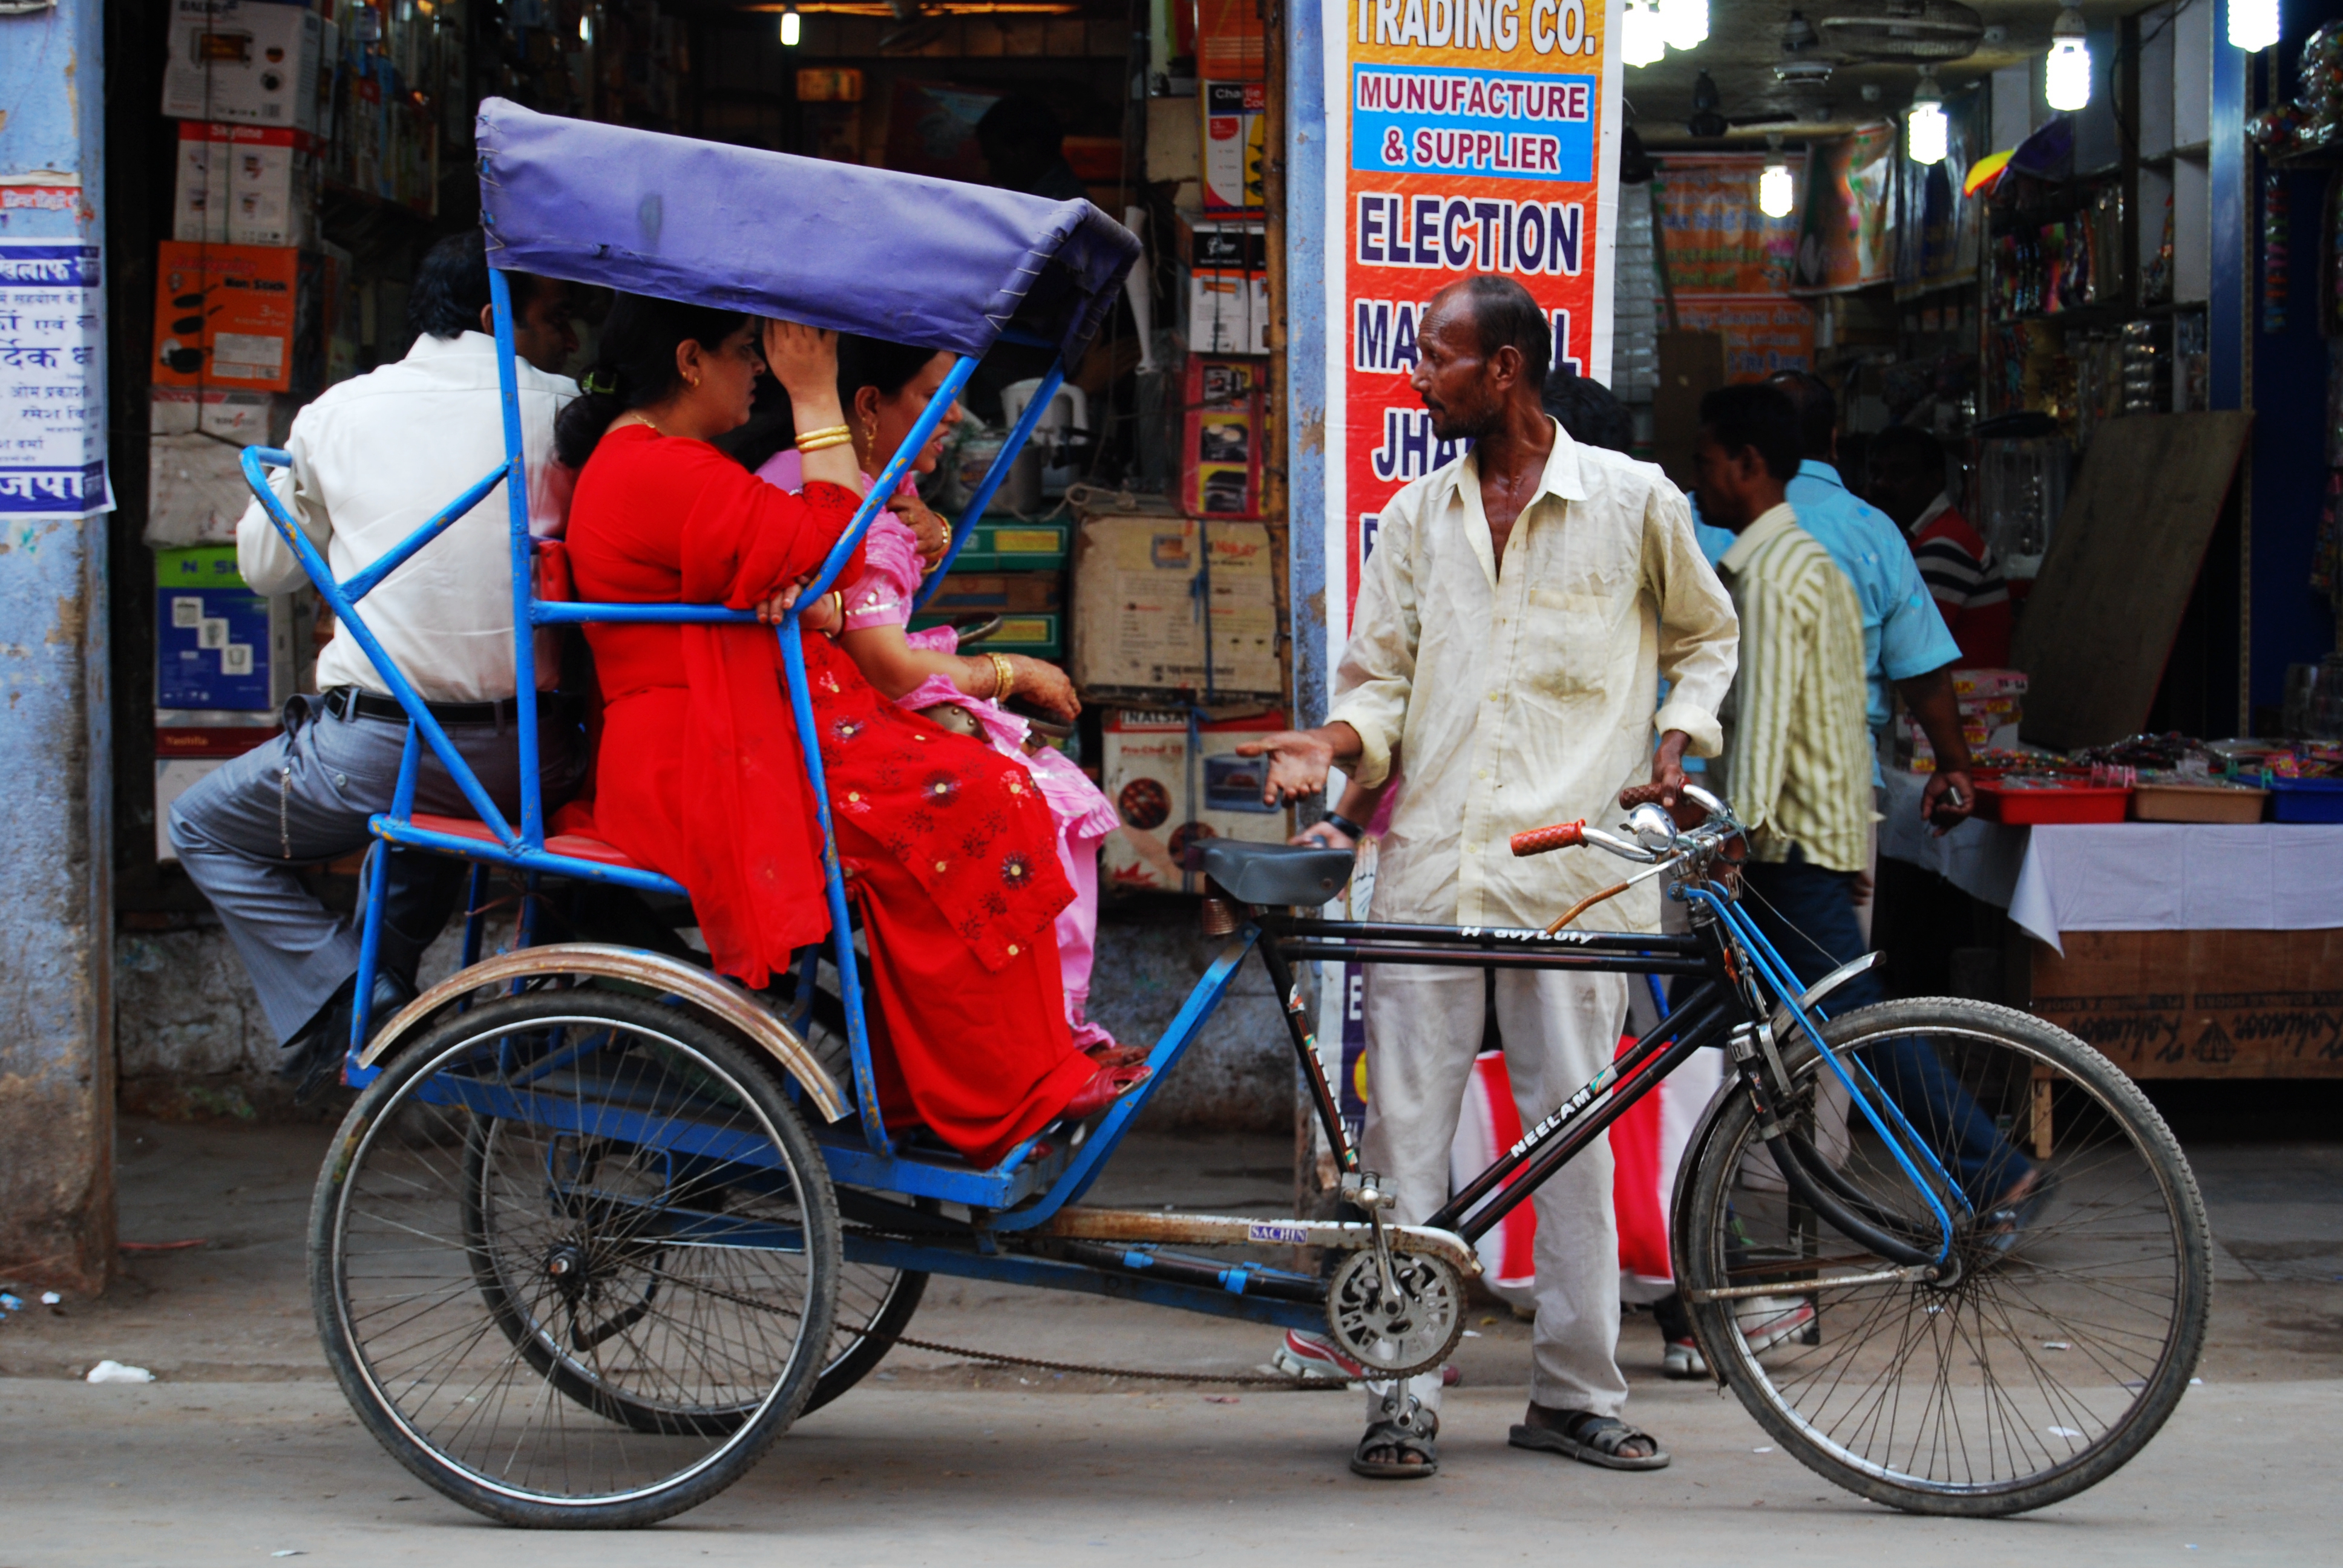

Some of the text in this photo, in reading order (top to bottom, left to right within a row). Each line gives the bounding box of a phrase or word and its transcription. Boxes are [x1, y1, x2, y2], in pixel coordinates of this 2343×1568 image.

[1357, 0, 1596, 56] TRADING CO.
[1359, 75, 1587, 120] MUNUFACTURE
[1384, 129, 1559, 171] & SUPPLIER
[1360, 196, 1580, 272] ELECTION
[1510, 1088, 1592, 1158] NEELAM
[1251, 1226, 1306, 1243] SACHIN
